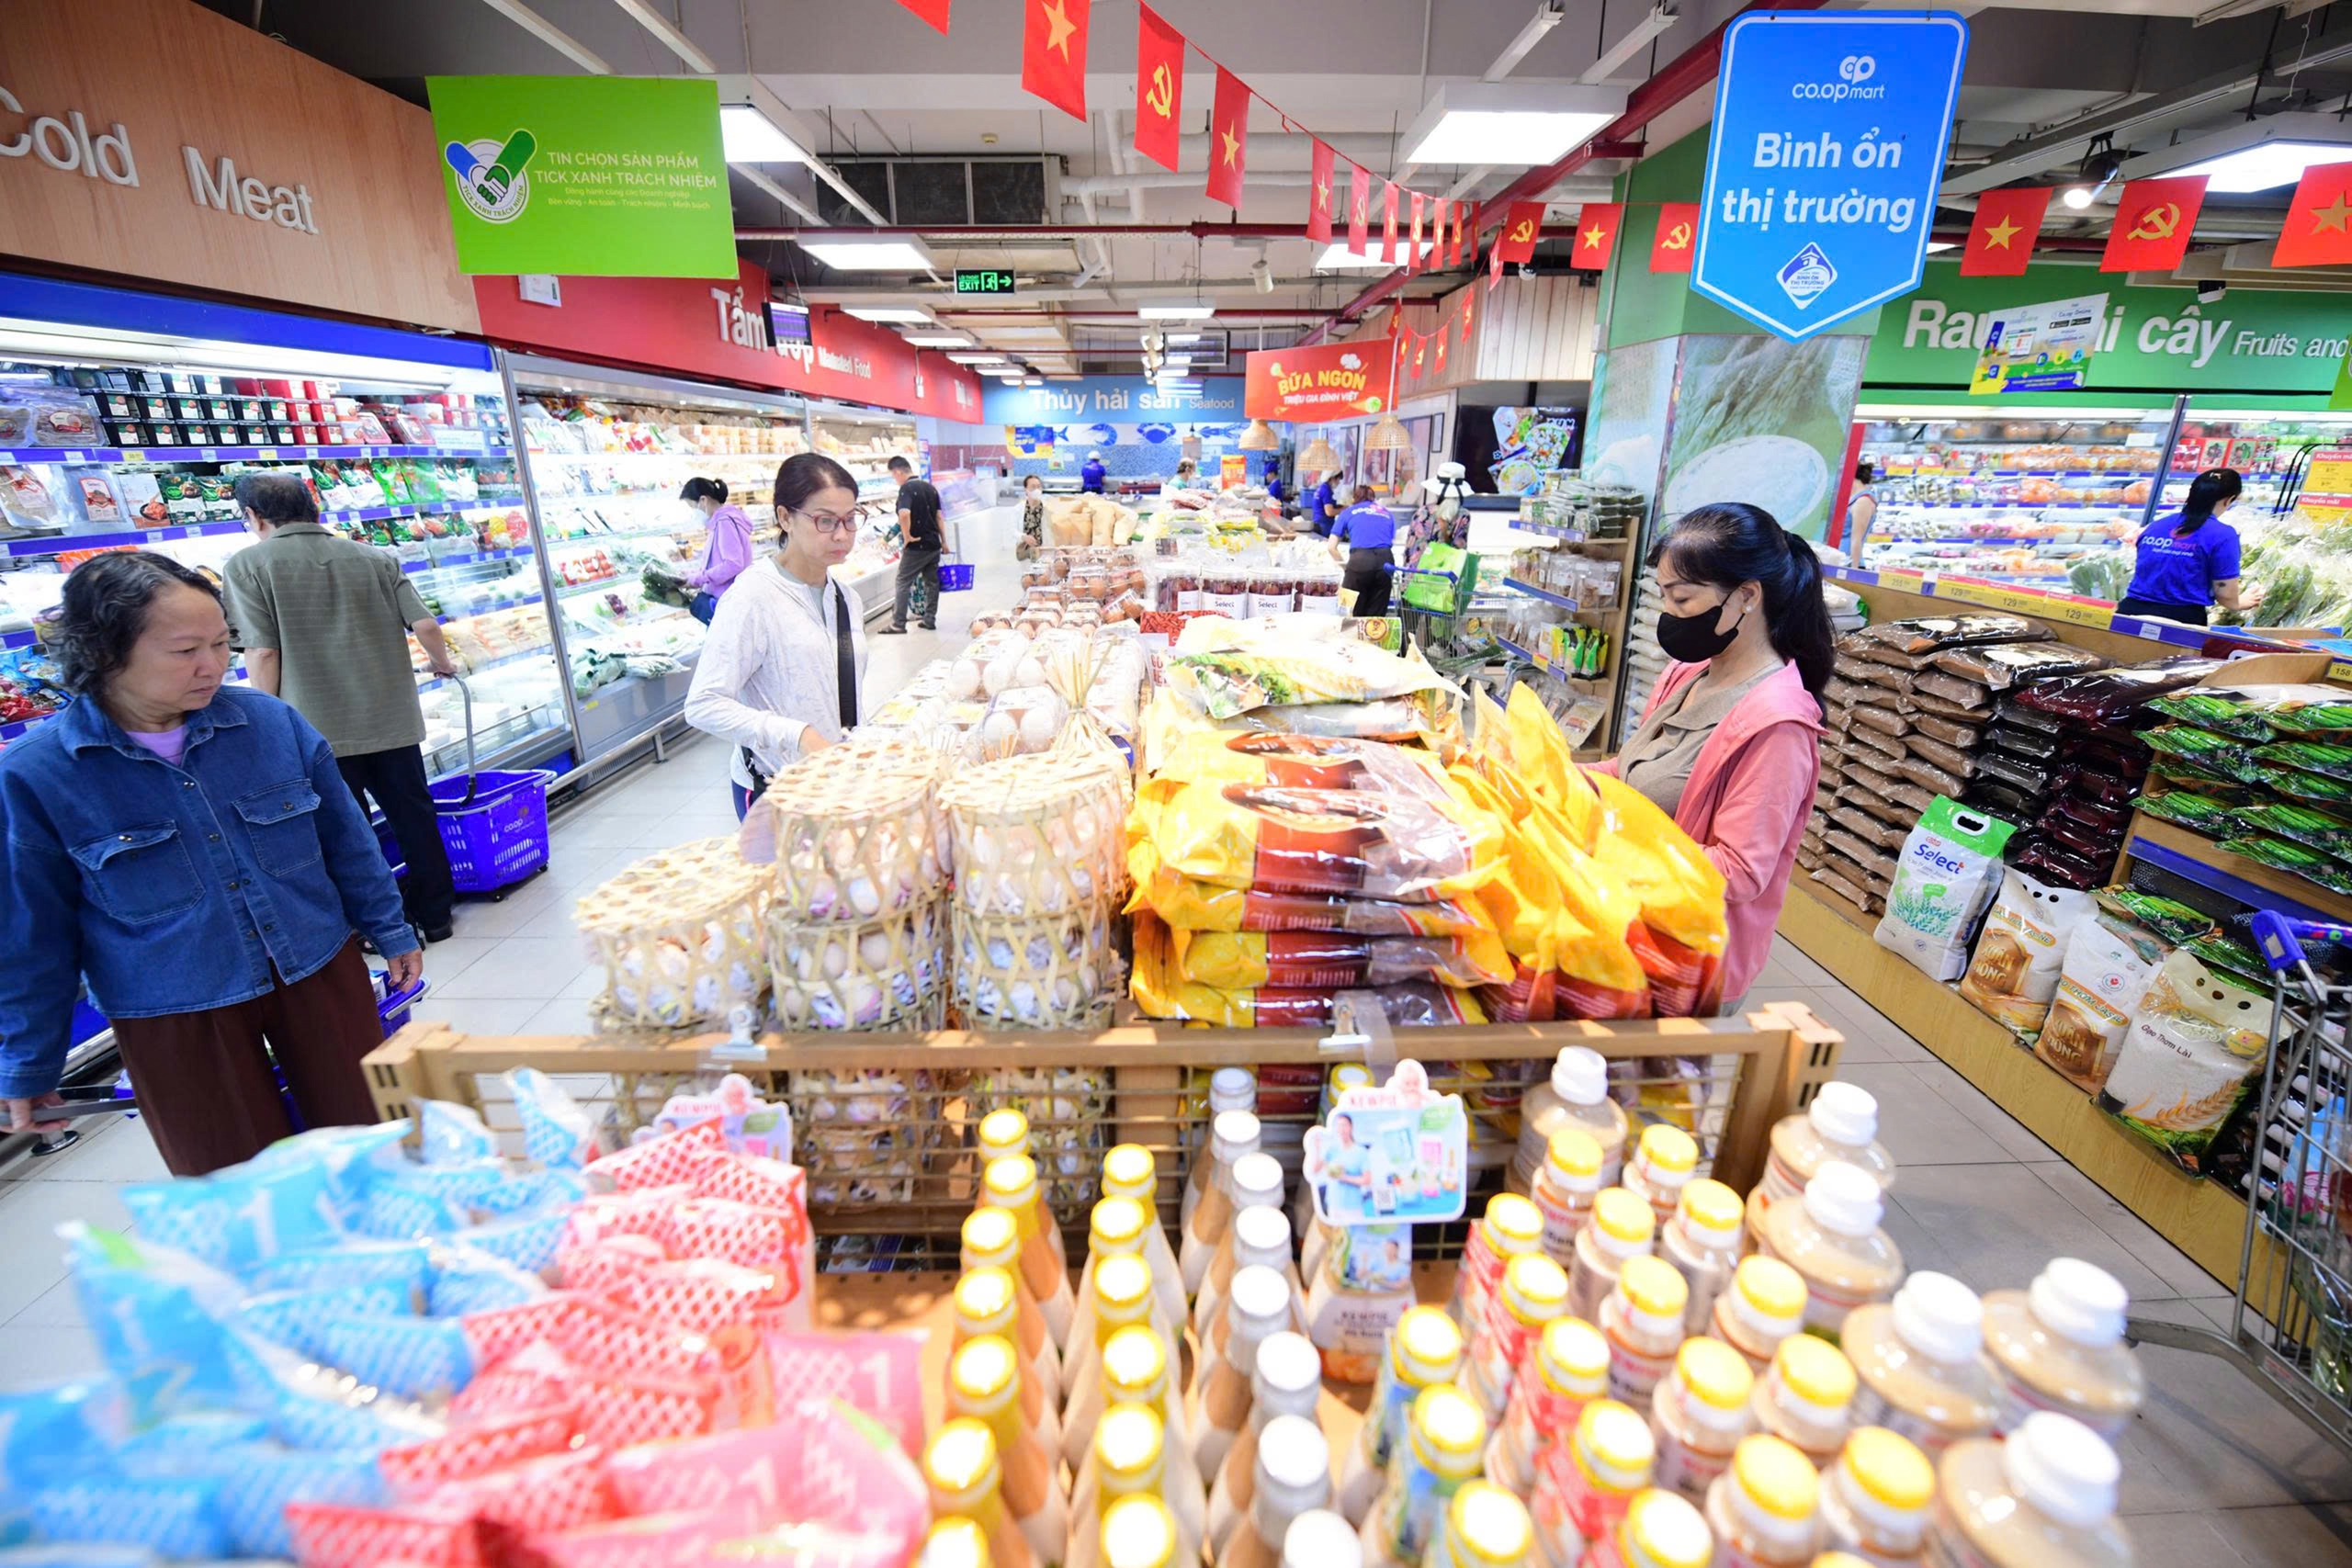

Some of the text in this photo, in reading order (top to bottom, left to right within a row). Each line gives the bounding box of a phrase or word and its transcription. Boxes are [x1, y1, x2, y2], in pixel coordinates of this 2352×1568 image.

[1753, 127, 1902, 169] Bình ổn
[548, 152, 572, 165] TIN
[535, 171, 568, 184] TICK
[571, 172, 611, 185] XANH
[181, 144, 318, 234] Meat
[1722, 187, 1916, 233] thị trường
[958, 281, 979, 291] EXIT
[2136, 306, 2232, 368] cây
[2233, 330, 2299, 356] Fruits
[1278, 370, 1367, 396] BỮA NGON
[1189, 397, 1235, 410] Seafood
[1951, 588, 1963, 596] 129
[2003, 597, 2017, 607] 129
[2065, 609, 2082, 620] 129
[2335, 667, 2351, 677] 158
[1914, 843, 1965, 874] Select
[2141, 1023, 2156, 1038] Gạo
[2157, 1032, 2177, 1050] Thơm
[2177, 1045, 2192, 1059] Lài
